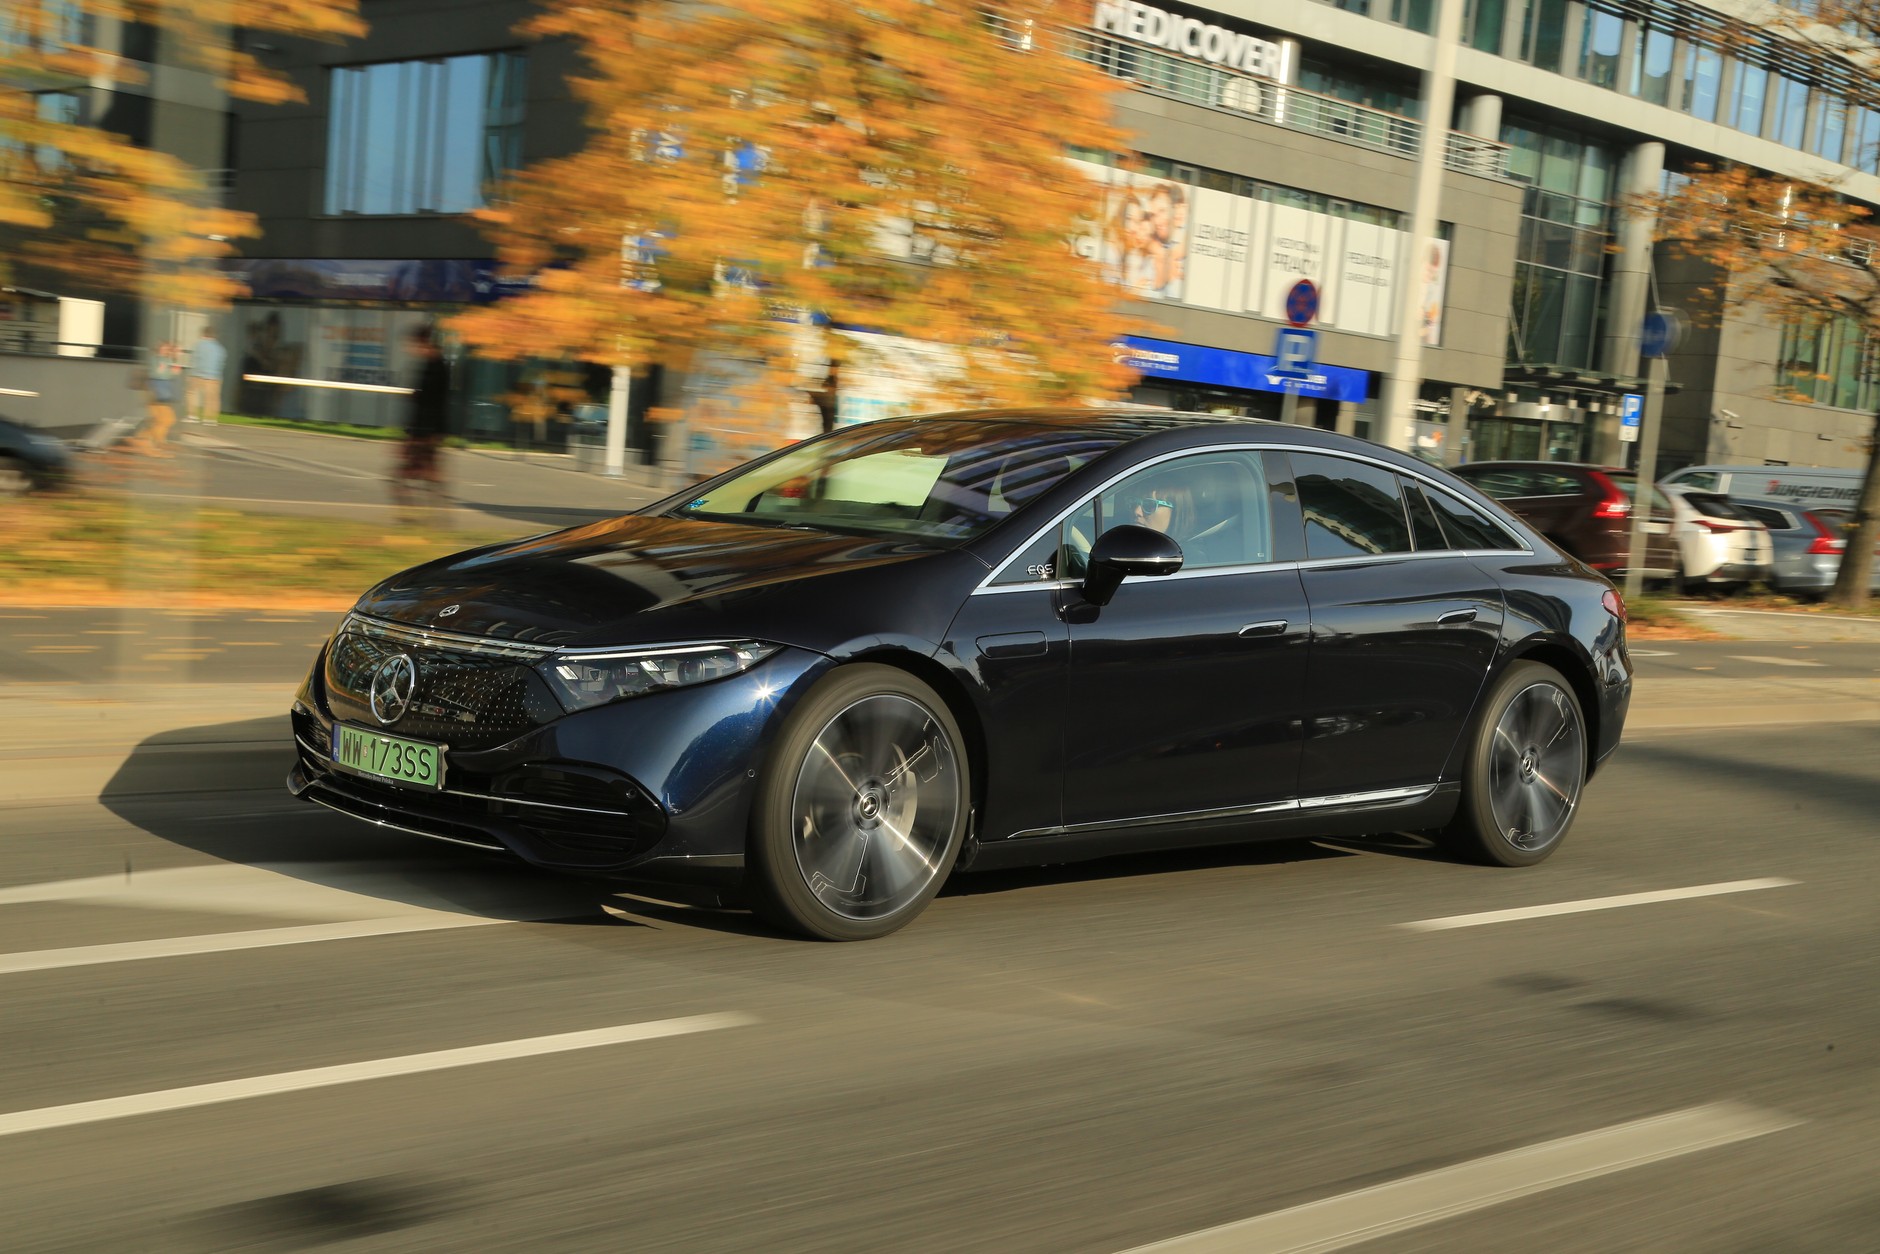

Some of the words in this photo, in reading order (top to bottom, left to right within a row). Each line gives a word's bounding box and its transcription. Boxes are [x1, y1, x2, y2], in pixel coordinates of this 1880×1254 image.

[1094, 0, 1281, 79] MEDICOVER
[1625, 398, 1640, 416] P
[1028, 564, 1053, 575] EQS
[343, 731, 362, 765] WW
[370, 737, 432, 780] 173SS
